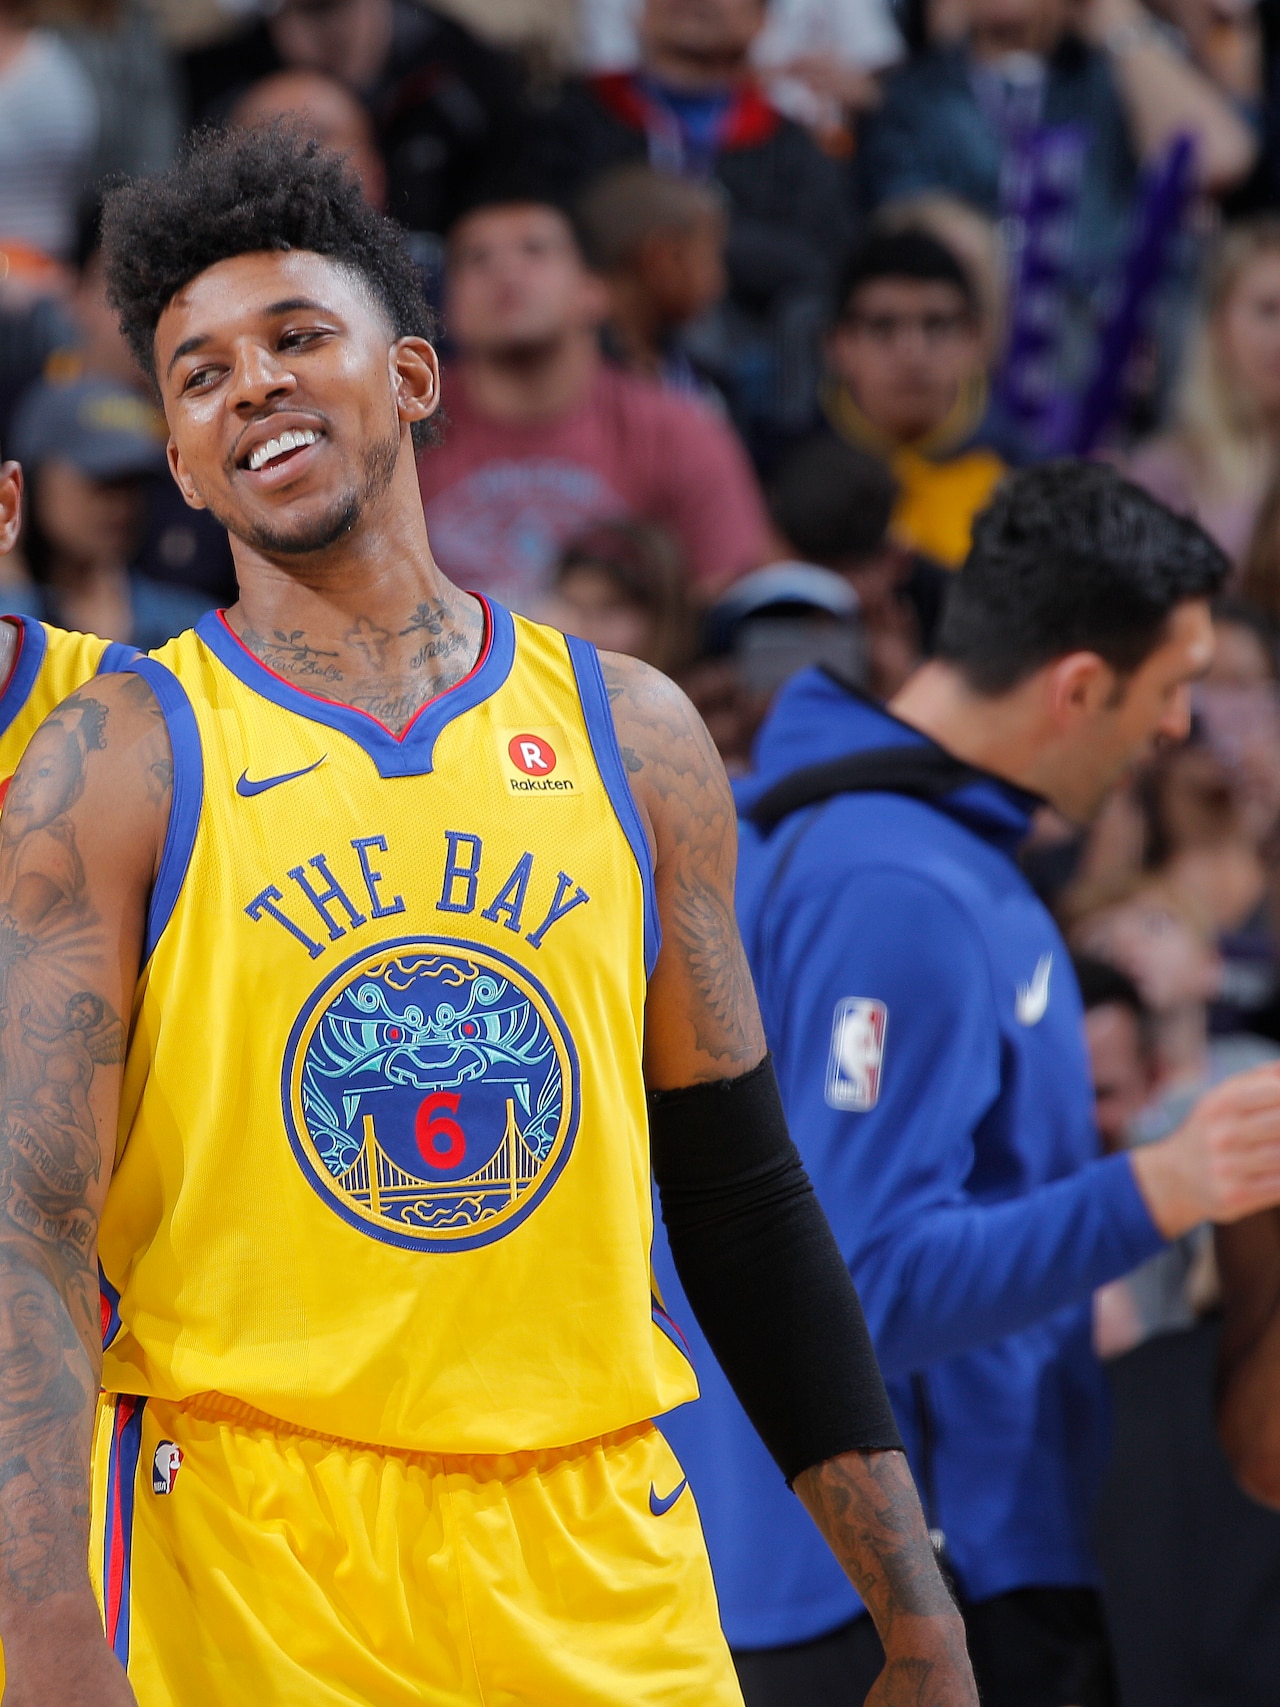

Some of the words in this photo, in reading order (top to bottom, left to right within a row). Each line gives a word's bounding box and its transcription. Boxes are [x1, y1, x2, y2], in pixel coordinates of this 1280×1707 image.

[524, 742, 548, 769] R
[510, 778, 574, 791] Rakuten
[243, 834, 406, 960] THE
[436, 829, 590, 949] BAY
[415, 1091, 466, 1170] 6
[67, 1217, 91, 1246] ME
